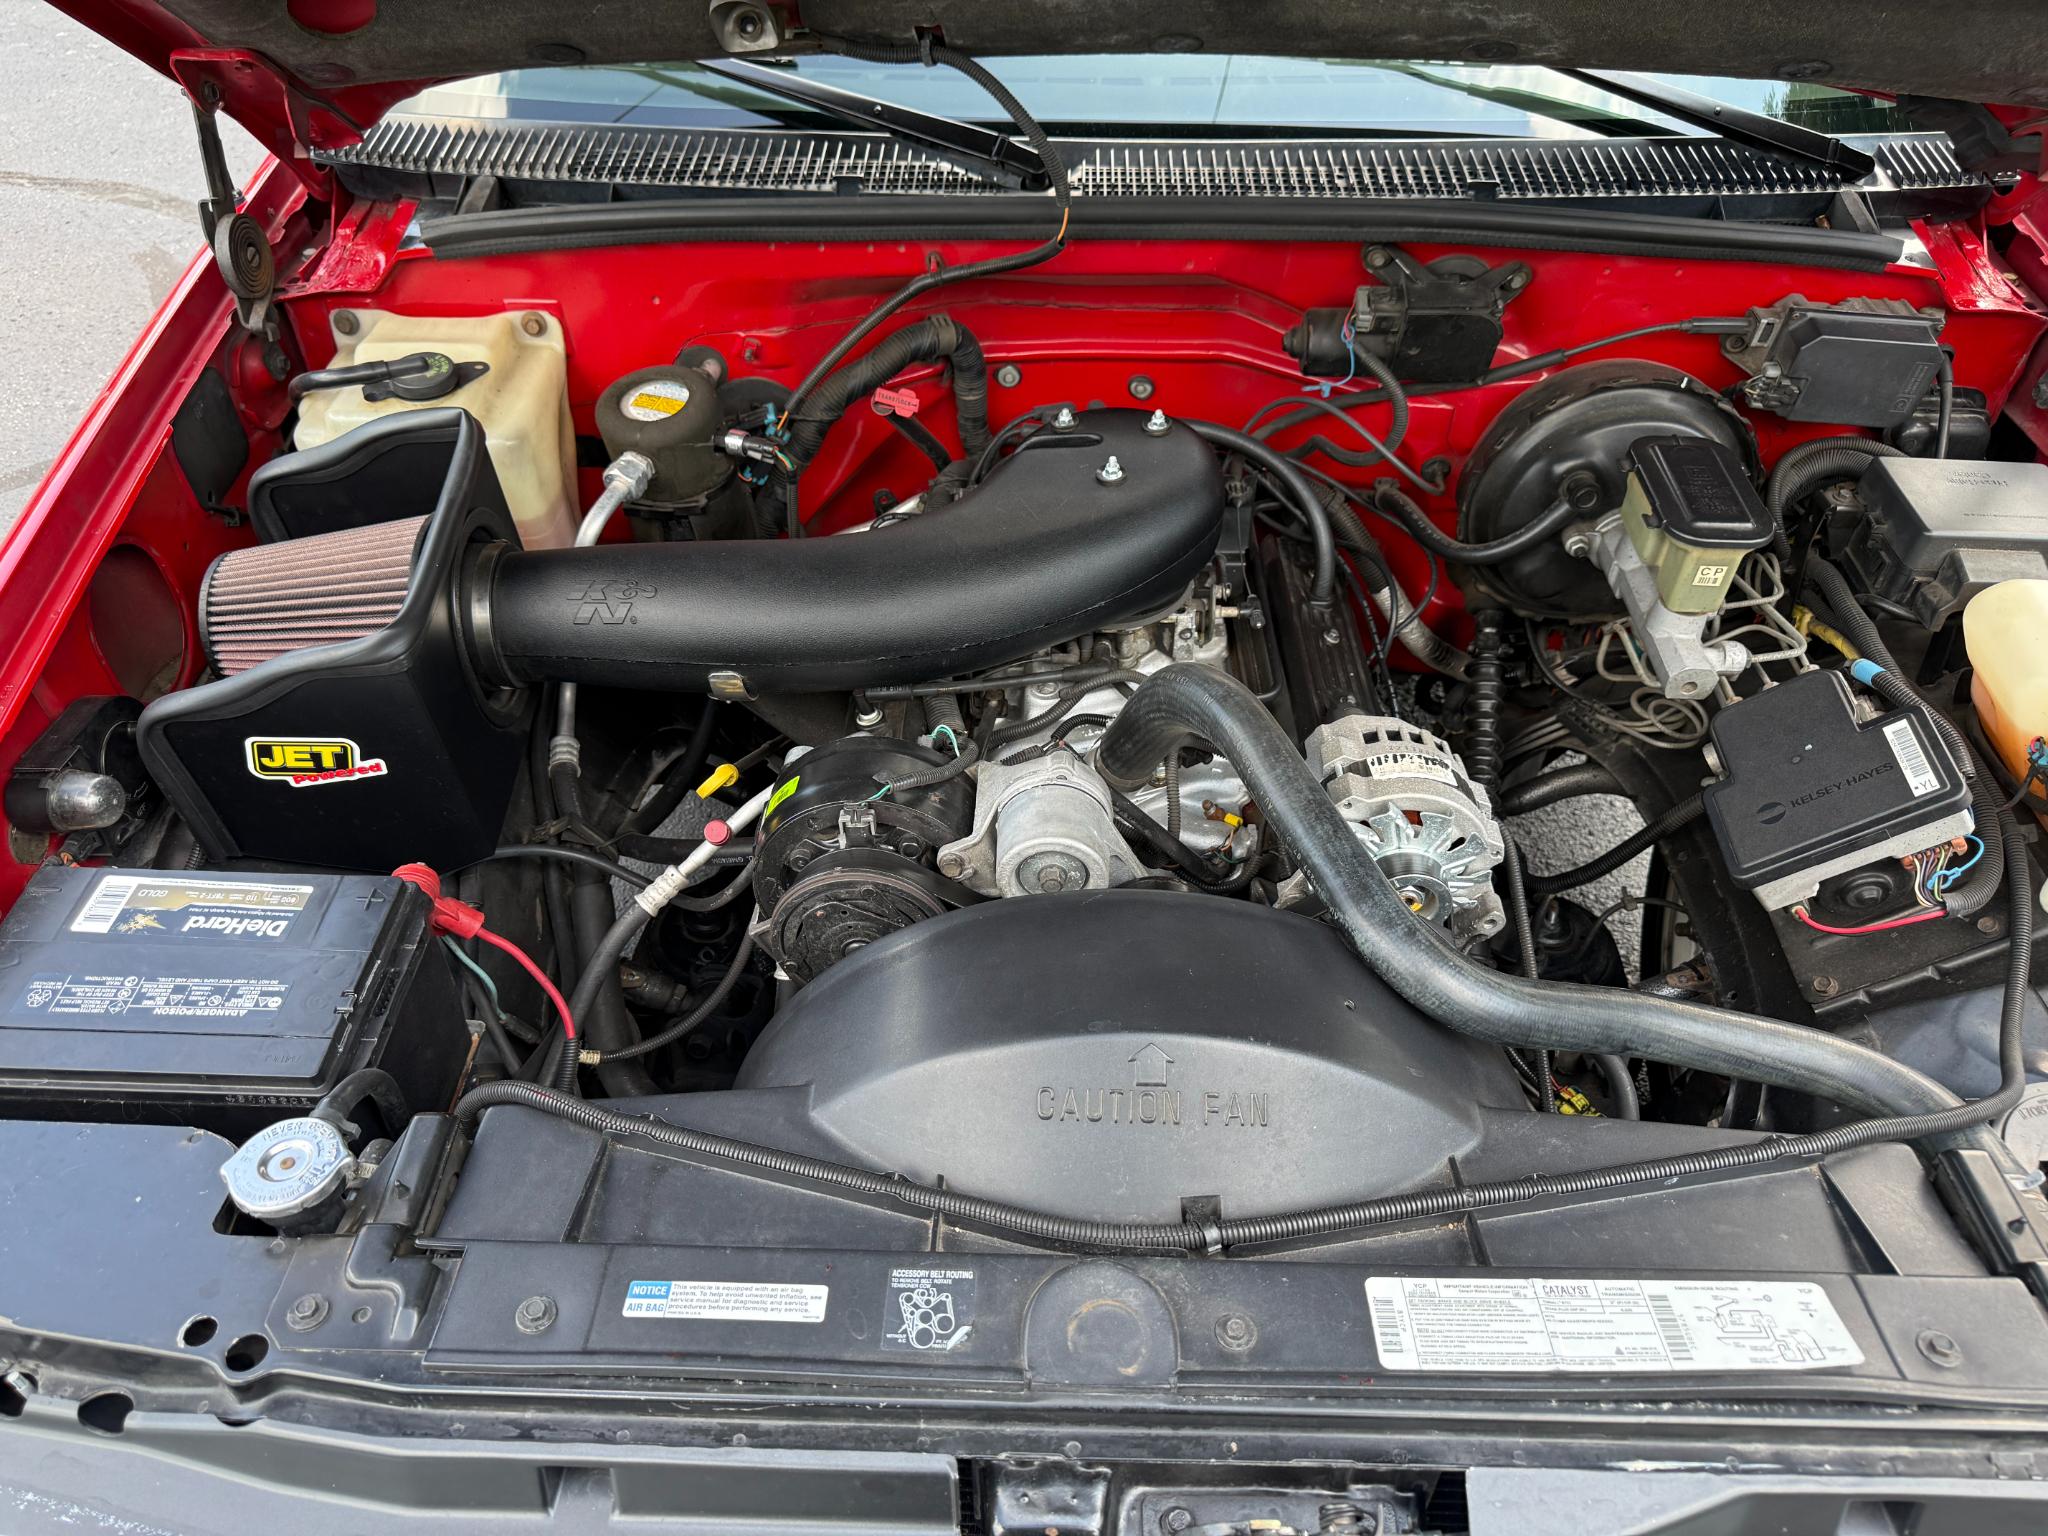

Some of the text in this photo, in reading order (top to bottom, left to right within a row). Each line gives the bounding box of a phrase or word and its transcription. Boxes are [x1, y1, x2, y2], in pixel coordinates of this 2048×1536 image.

[260, 745, 343, 768] JET
[292, 762, 383, 784] Powered
[138, 888, 168, 898] GOLD
[181, 915, 288, 937] DieHard
[153, 1007, 238, 1016] DANGER/POISON
[1037, 1086, 1268, 1127] CAUTION FAN
[262, 1121, 303, 1142] NEVER
[892, 1270, 973, 1279] ACCESSORY BELT ROUTING
[632, 1285, 667, 1296] NOTICE
[1542, 1285, 1589, 1295] CATALYST
[626, 1302, 664, 1312] AIR BAG
